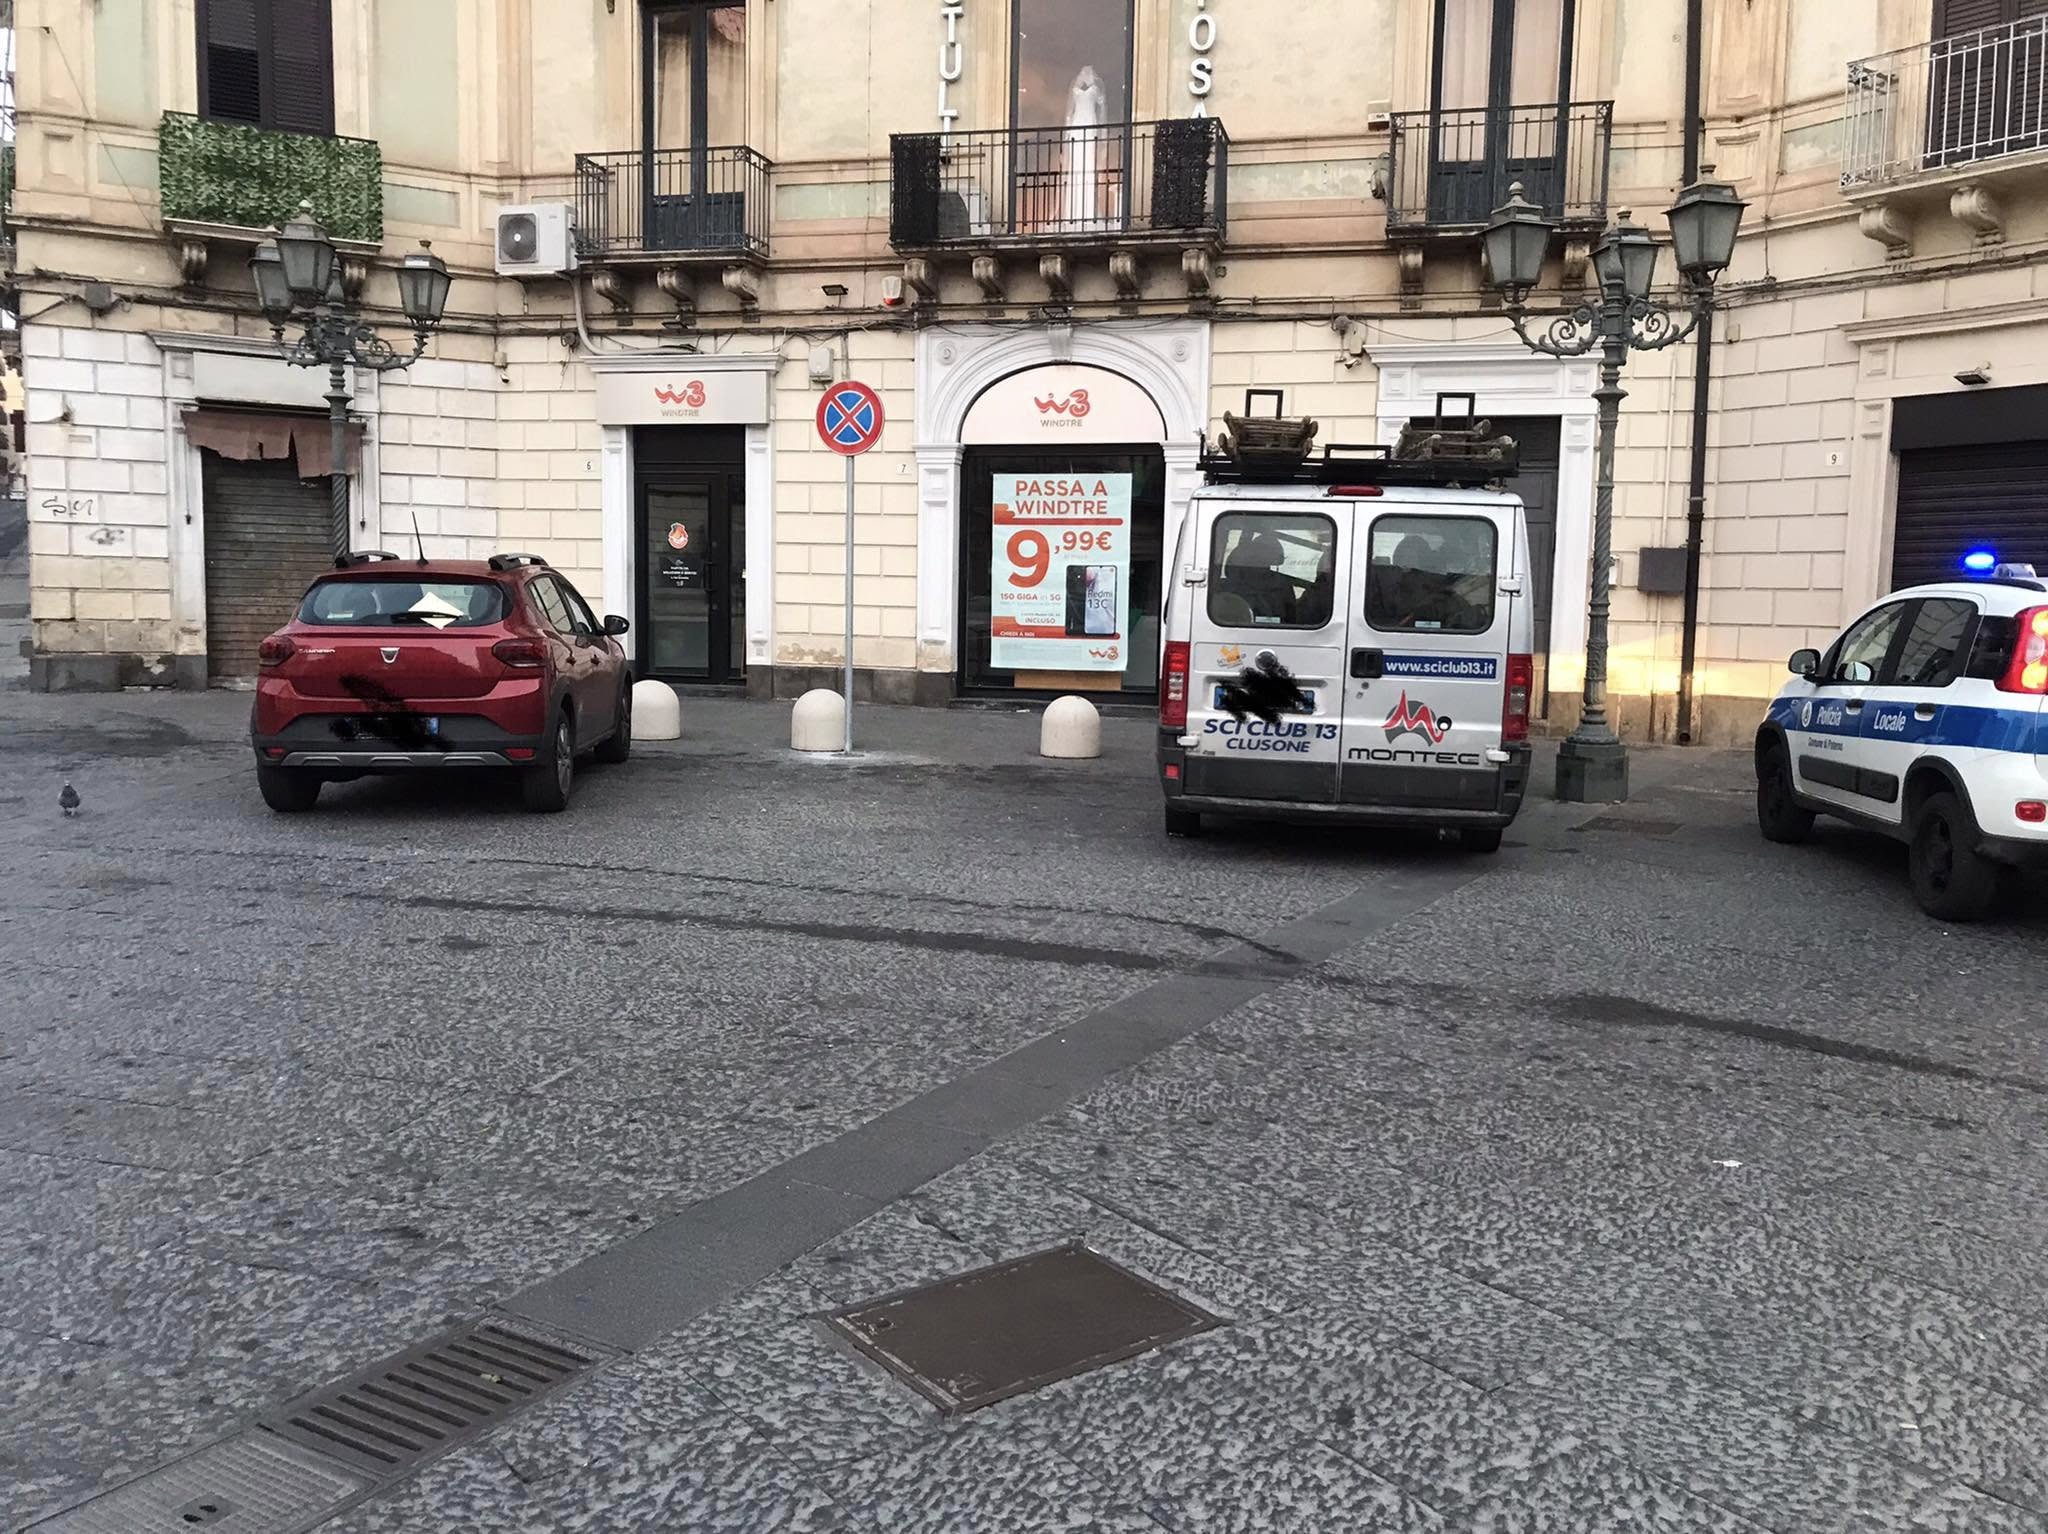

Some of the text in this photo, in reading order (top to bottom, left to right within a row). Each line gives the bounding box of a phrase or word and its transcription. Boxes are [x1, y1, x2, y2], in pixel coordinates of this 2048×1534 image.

[661, 409, 700, 417] WINDTRE
[1040, 419, 1083, 428] WINDTRE
[1831, 454, 1837, 465] 9
[586, 461, 592, 470] 6
[901, 464, 907, 473] 7
[1015, 480, 1109, 496] PASSA A
[1015, 500, 1108, 515] WINDTRE
[1000, 592, 1015, 601] 150
[1016, 592, 1039, 601] GIGA
[1087, 589, 1113, 599] Redmi
[1088, 599, 1108, 609] 13C
[1024, 617, 1056, 625] INCLUSO
[1385, 661, 1495, 675] www.sciclub13.it
[1816, 705, 1907, 732] Polizia Locale
[1203, 718, 1338, 740] SCI CLUB 13
[1226, 737, 1311, 753] CLUSONE
[1348, 748, 1480, 766] MONTEC
